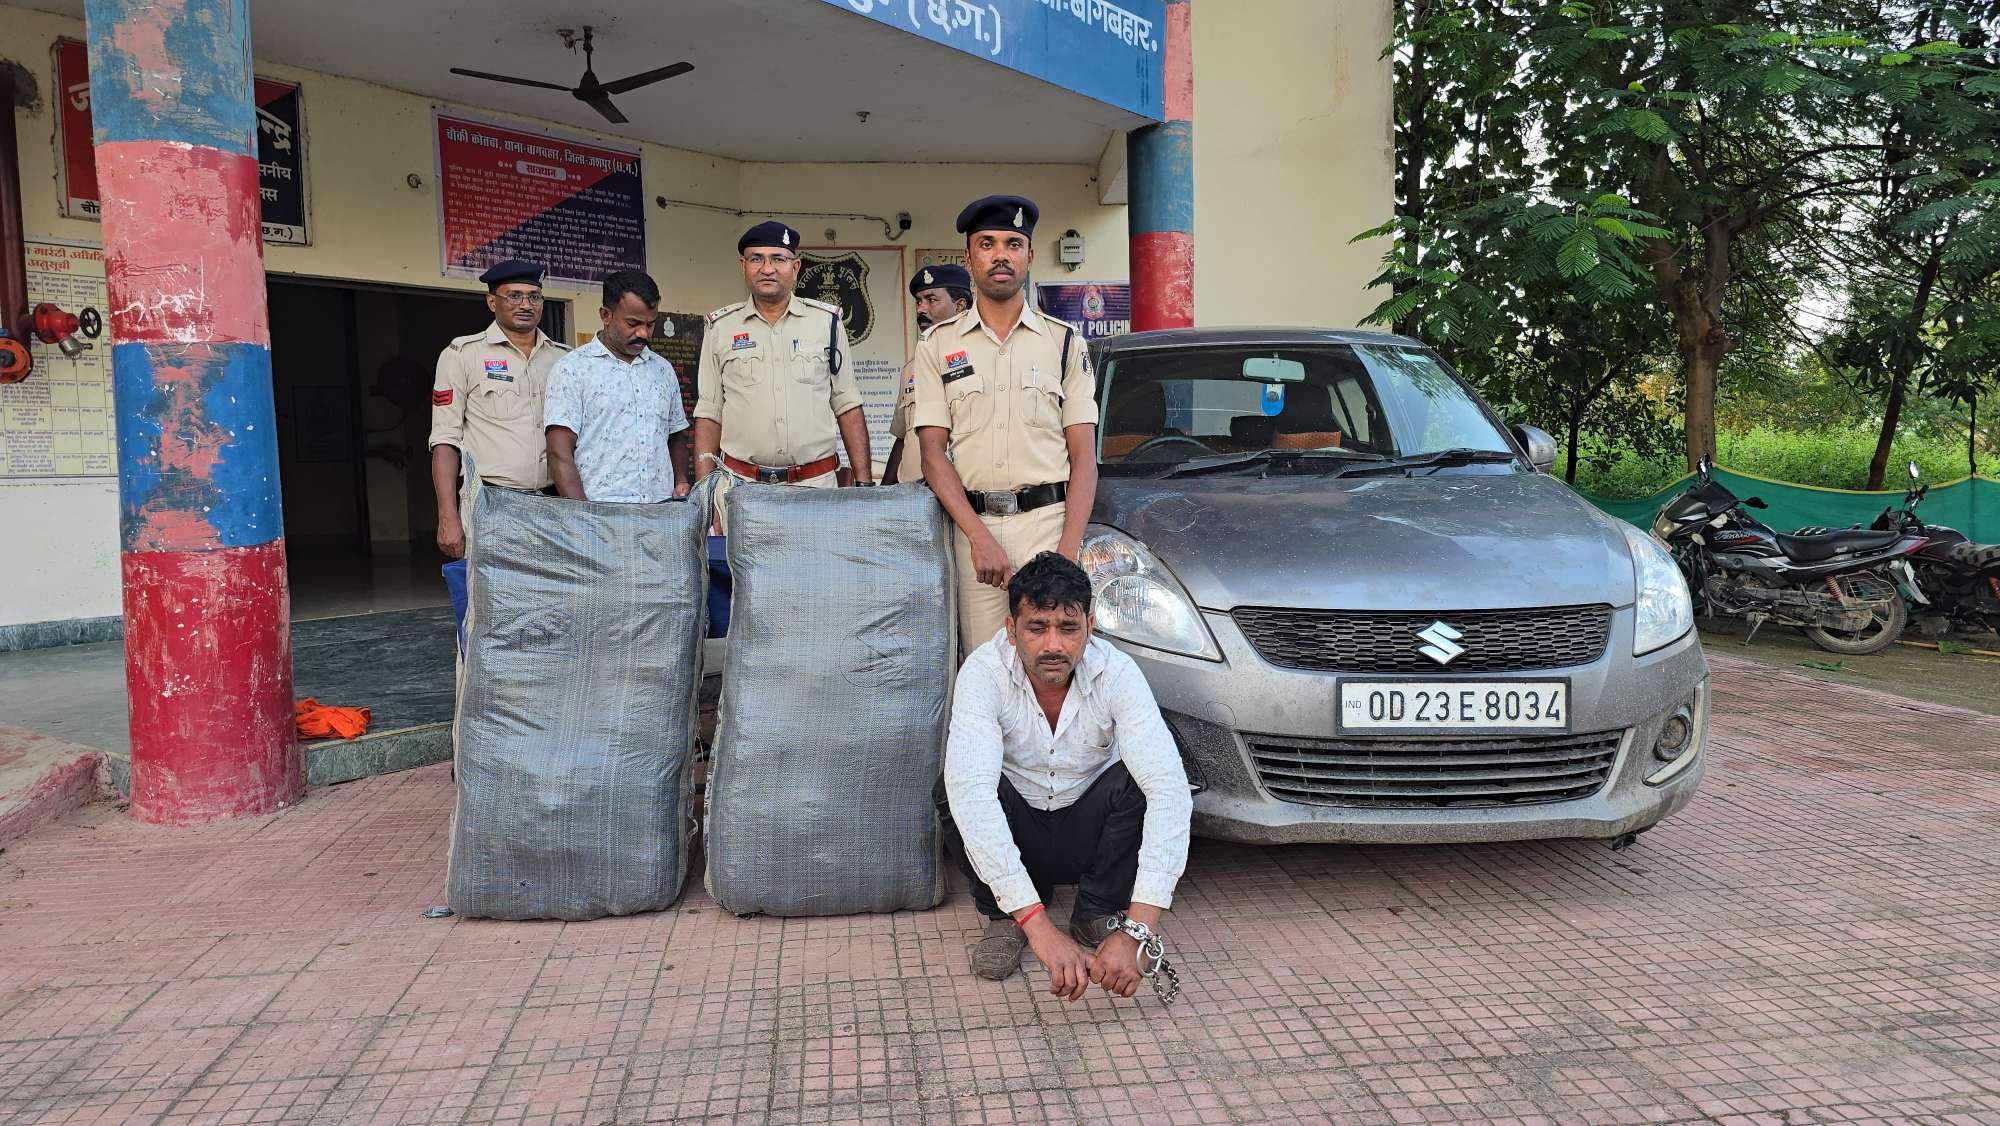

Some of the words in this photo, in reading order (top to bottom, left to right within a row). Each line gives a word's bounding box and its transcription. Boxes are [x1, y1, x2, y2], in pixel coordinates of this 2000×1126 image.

[526, 161, 556, 178] सावधान
[1088, 319, 1130, 336] POLICIN
[1345, 699, 1362, 710] IND
[1415, 690, 1450, 721] 23
[1460, 690, 1476, 721] E
[1484, 690, 1561, 721] 8034
